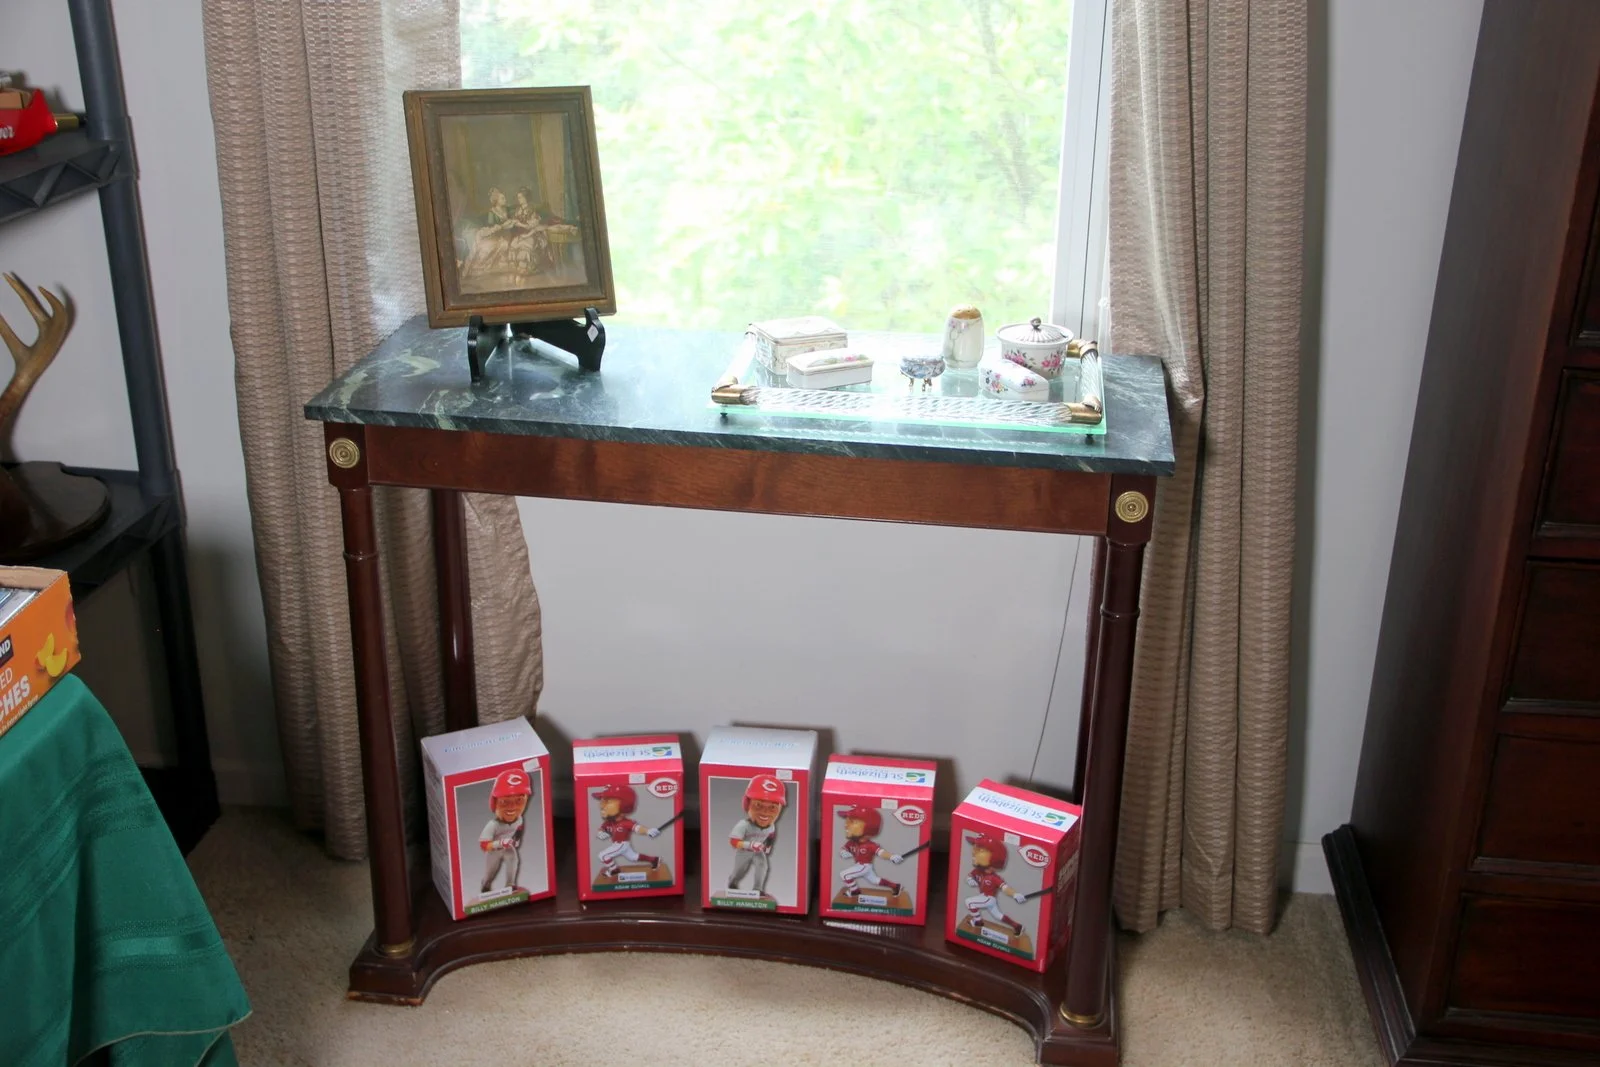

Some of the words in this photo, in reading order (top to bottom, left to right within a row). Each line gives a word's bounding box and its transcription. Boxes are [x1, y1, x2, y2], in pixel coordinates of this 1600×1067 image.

[583, 750, 635, 758] Elizabeth
[836, 767, 888, 779] Elizabeth
[978, 793, 1029, 815] Elizabeth
[902, 812, 925, 821] REDS
[1027, 851, 1050, 863] REDS
[470, 904, 488, 914] BILLY
[489, 896, 520, 909] HAMILTON
[735, 901, 768, 909] HAMILTON
